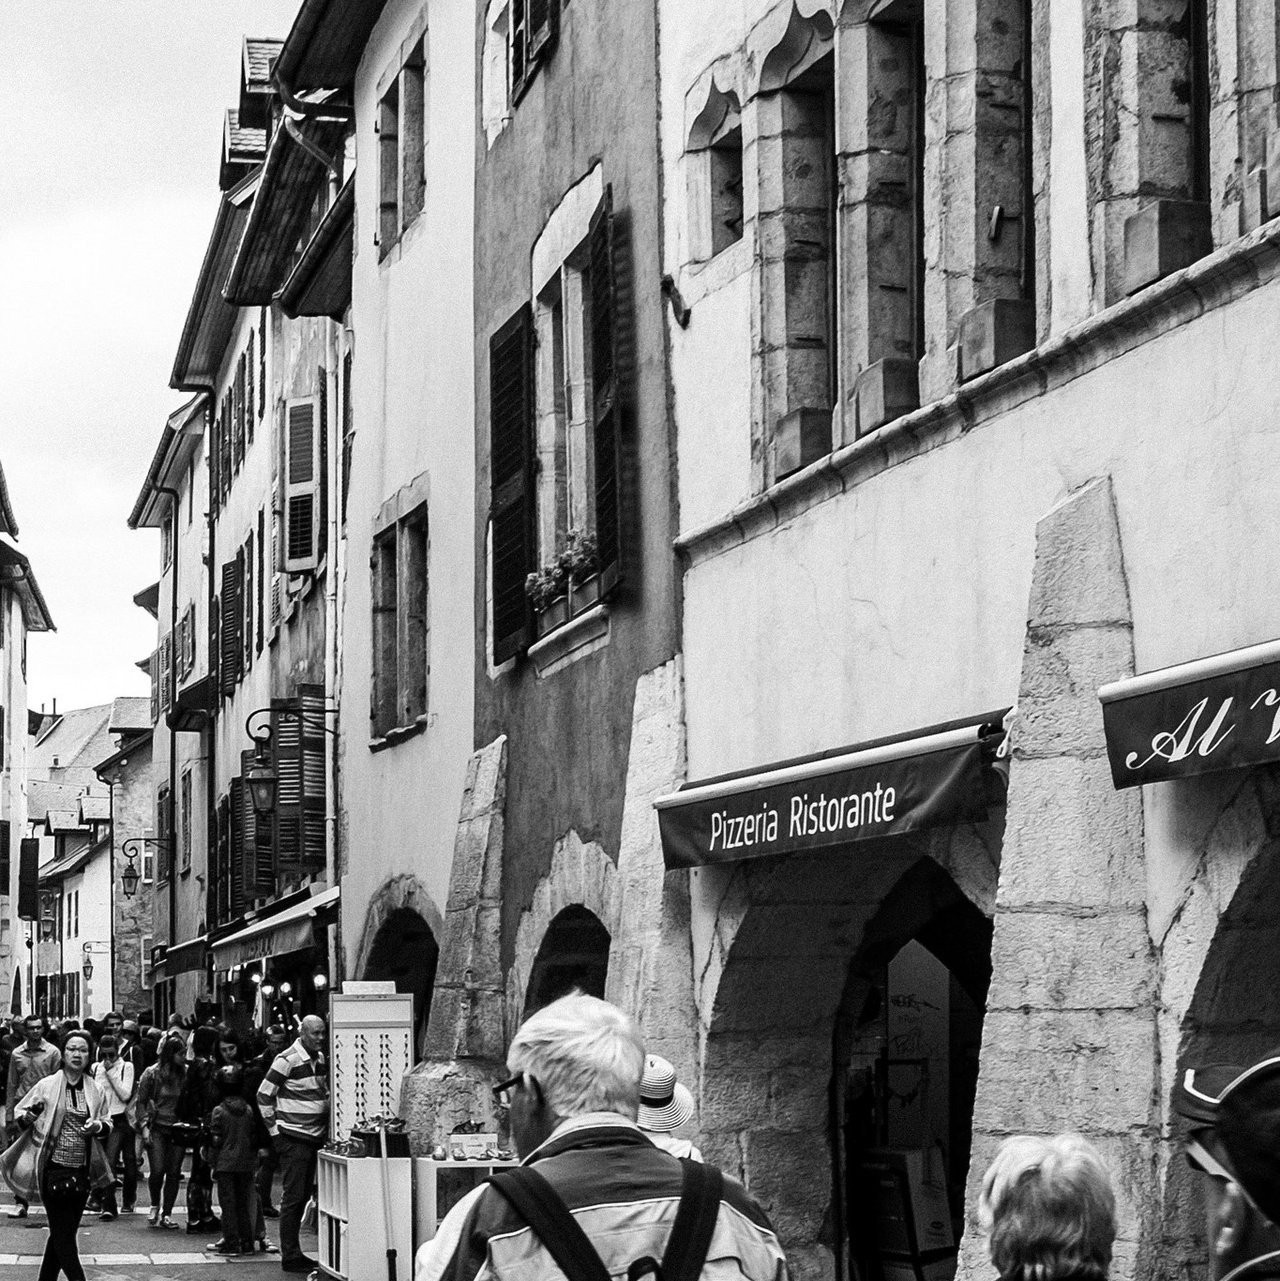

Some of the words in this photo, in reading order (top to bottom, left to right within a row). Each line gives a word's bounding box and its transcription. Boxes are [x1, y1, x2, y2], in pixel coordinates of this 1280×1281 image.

[1125, 696, 1236, 770] Al
[709, 802, 779, 851] Pizzeria
[789, 782, 896, 838] Ristorante
